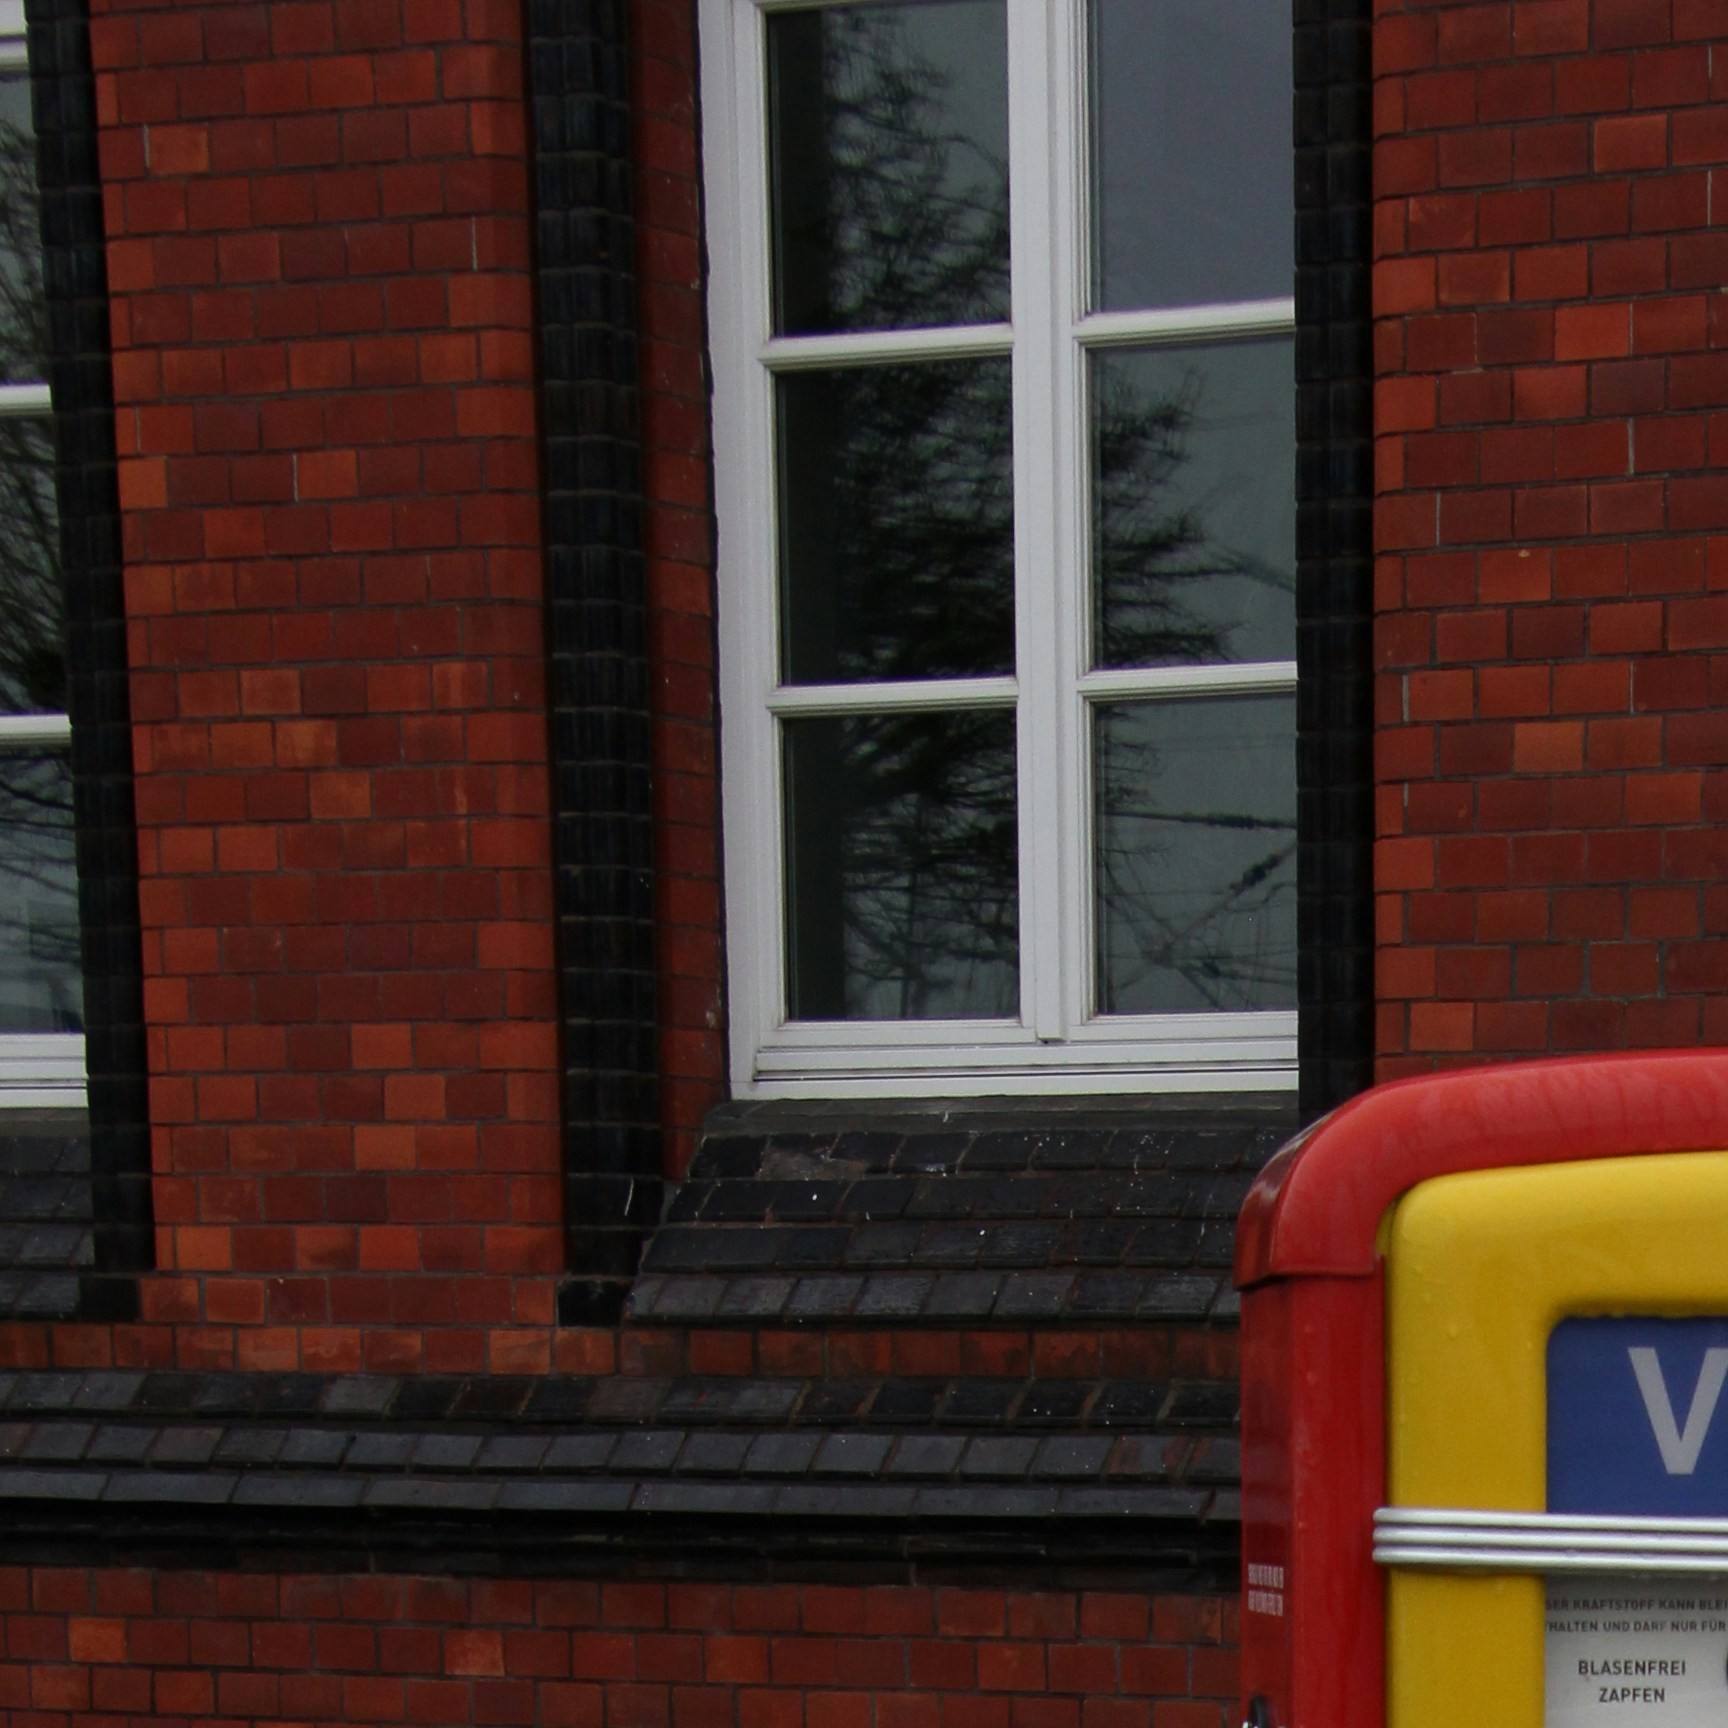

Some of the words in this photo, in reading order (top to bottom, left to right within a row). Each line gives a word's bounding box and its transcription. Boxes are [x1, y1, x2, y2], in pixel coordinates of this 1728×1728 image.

[1573, 1600, 1652, 1612] KRAFTSTOFF
[1658, 1600, 1695, 1612] KANN
[1699, 1600, 1728, 1611] BLEI
[1603, 1621, 1630, 1633] UND
[1670, 1620, 1698, 1633] NUR
[1701, 1618, 1727, 1633] FÜR
[1579, 1660, 1686, 1676] BLASENFREI
[1599, 1688, 1665, 1703] ZAPFEN
